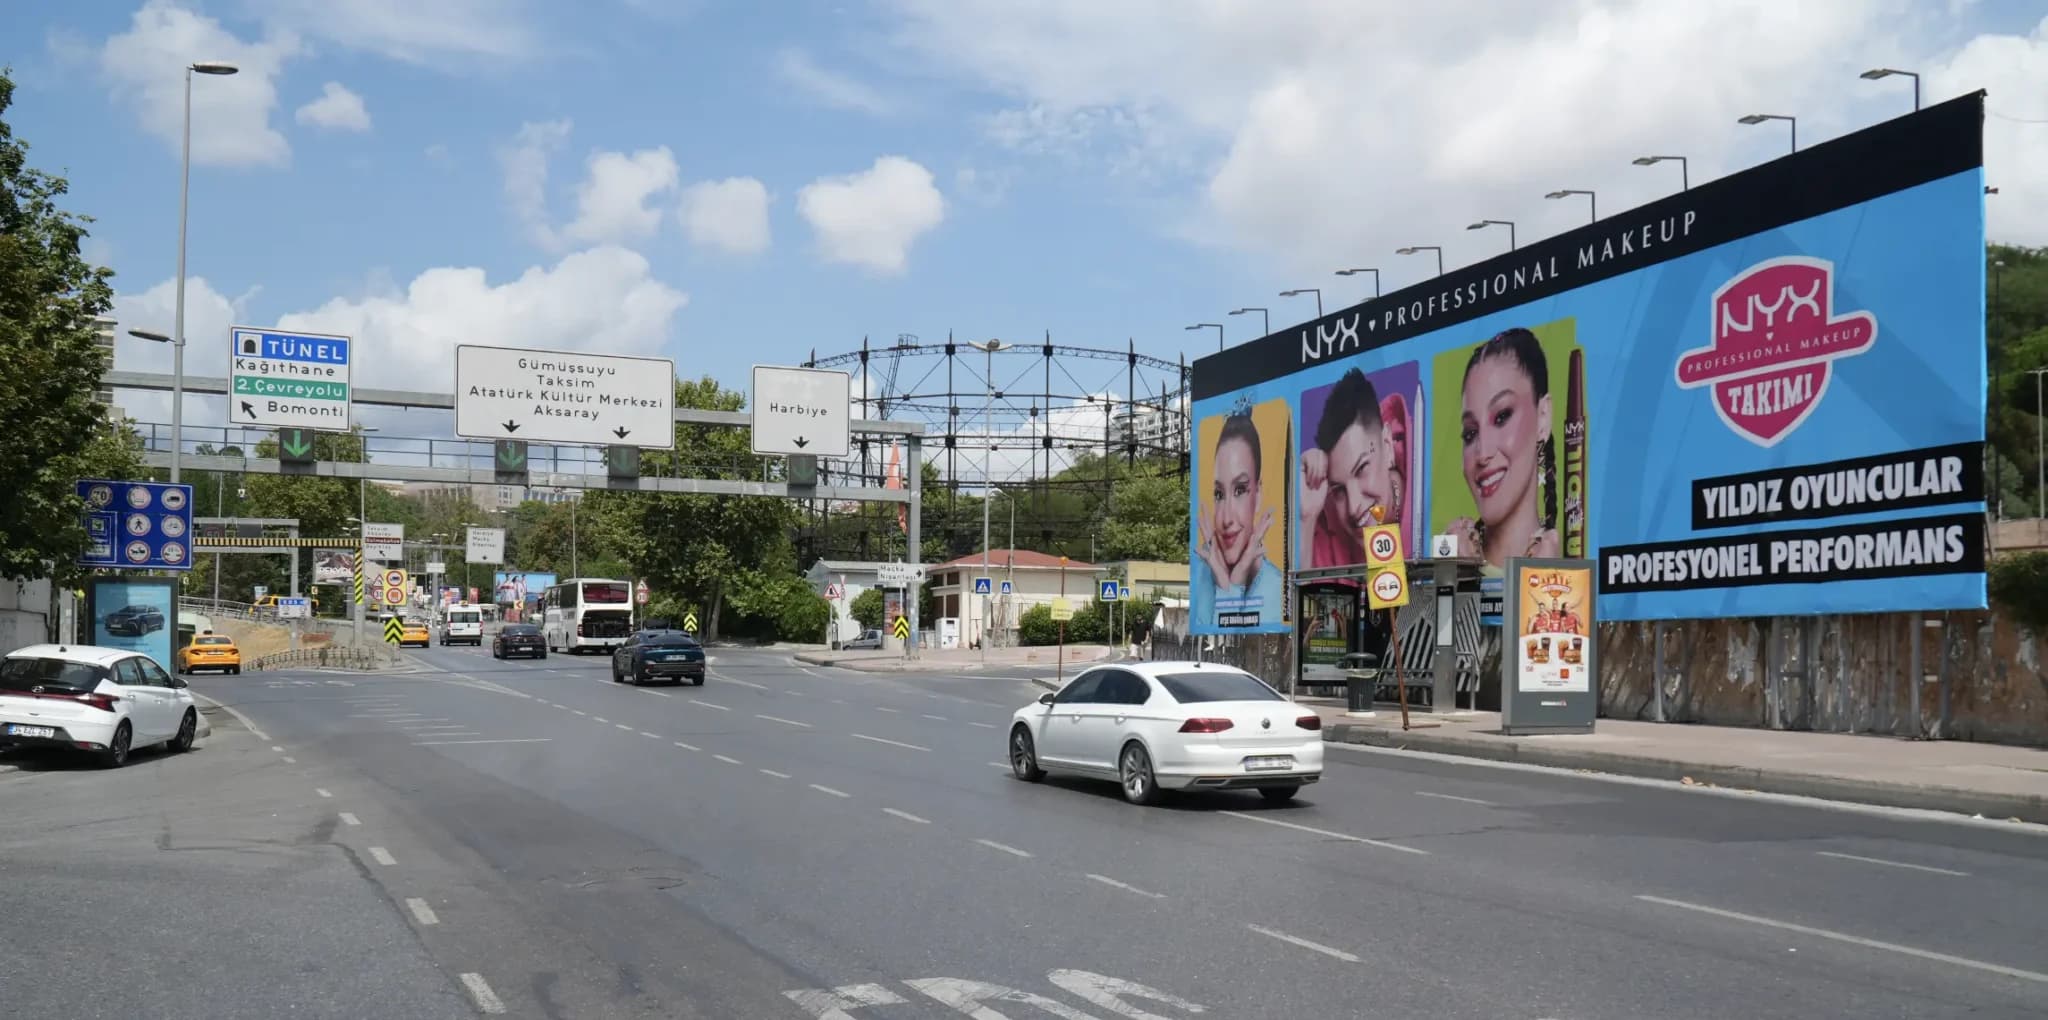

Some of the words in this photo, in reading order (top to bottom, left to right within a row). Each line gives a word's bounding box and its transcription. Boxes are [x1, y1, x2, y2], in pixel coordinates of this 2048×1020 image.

[1301, 313, 1360, 364] NYX
[1384, 256, 1560, 331] PROFESSIONAL
[1576, 210, 1697, 269] MAKEUP
[1722, 279, 1821, 338] NYX
[268, 339, 343, 360] TÜNEL
[1687, 343, 1791, 373] PROFESSIONAL
[1800, 327, 1861, 349] MAKEUP
[236, 358, 335, 376] Kağıthane
[518, 358, 616, 377] Gümüşsuyu
[237, 378, 250, 391] 2.
[255, 380, 343, 397] Çevreyolu
[537, 375, 595, 388] Taksim
[469, 386, 533, 399] Atatürk
[540, 390, 592, 404] Kültür
[599, 395, 663, 408] Merkezi
[1728, 373, 1813, 416] TAKIMI
[268, 401, 343, 417] Bomonti
[534, 405, 600, 421] Aksaray
[770, 402, 828, 418] Harbiye
[1702, 478, 1784, 520] YILDIZ
[1790, 455, 1963, 511] OYUNCULAR
[1376, 539, 1391, 553] 30
[1607, 542, 1763, 585] PROFESYONEL
[1770, 525, 1965, 574] PERFORMANS
